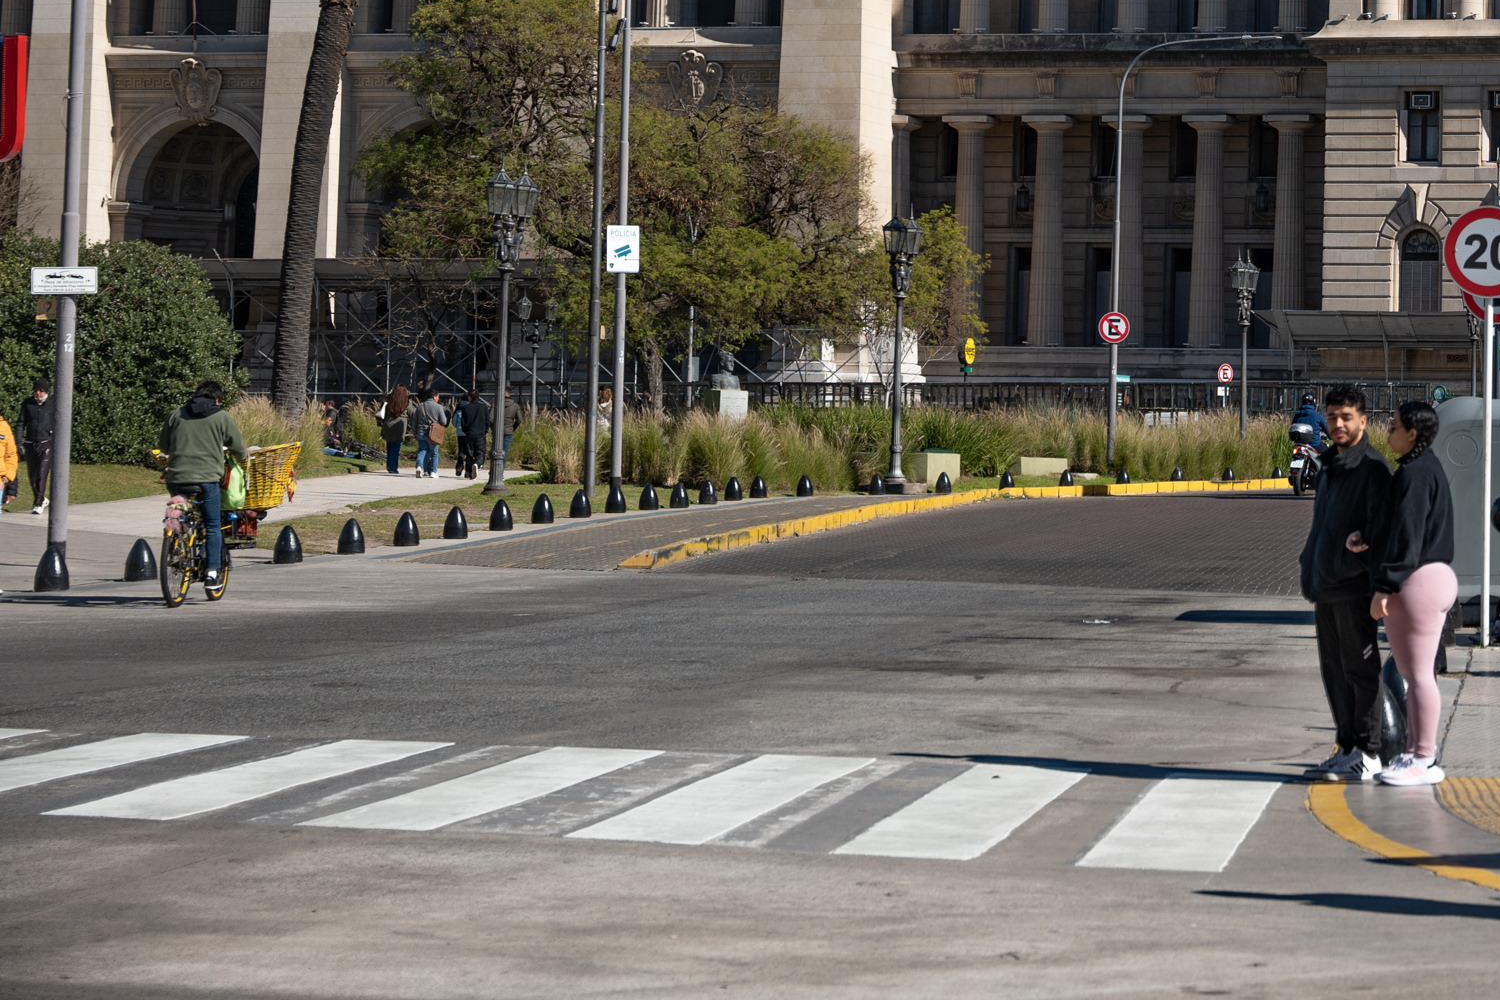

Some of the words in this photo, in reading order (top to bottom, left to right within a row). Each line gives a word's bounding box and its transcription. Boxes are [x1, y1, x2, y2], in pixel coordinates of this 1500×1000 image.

[1108, 318, 1121, 336] E
[65, 333, 72, 342] 2
[63, 343, 73, 352] 12
